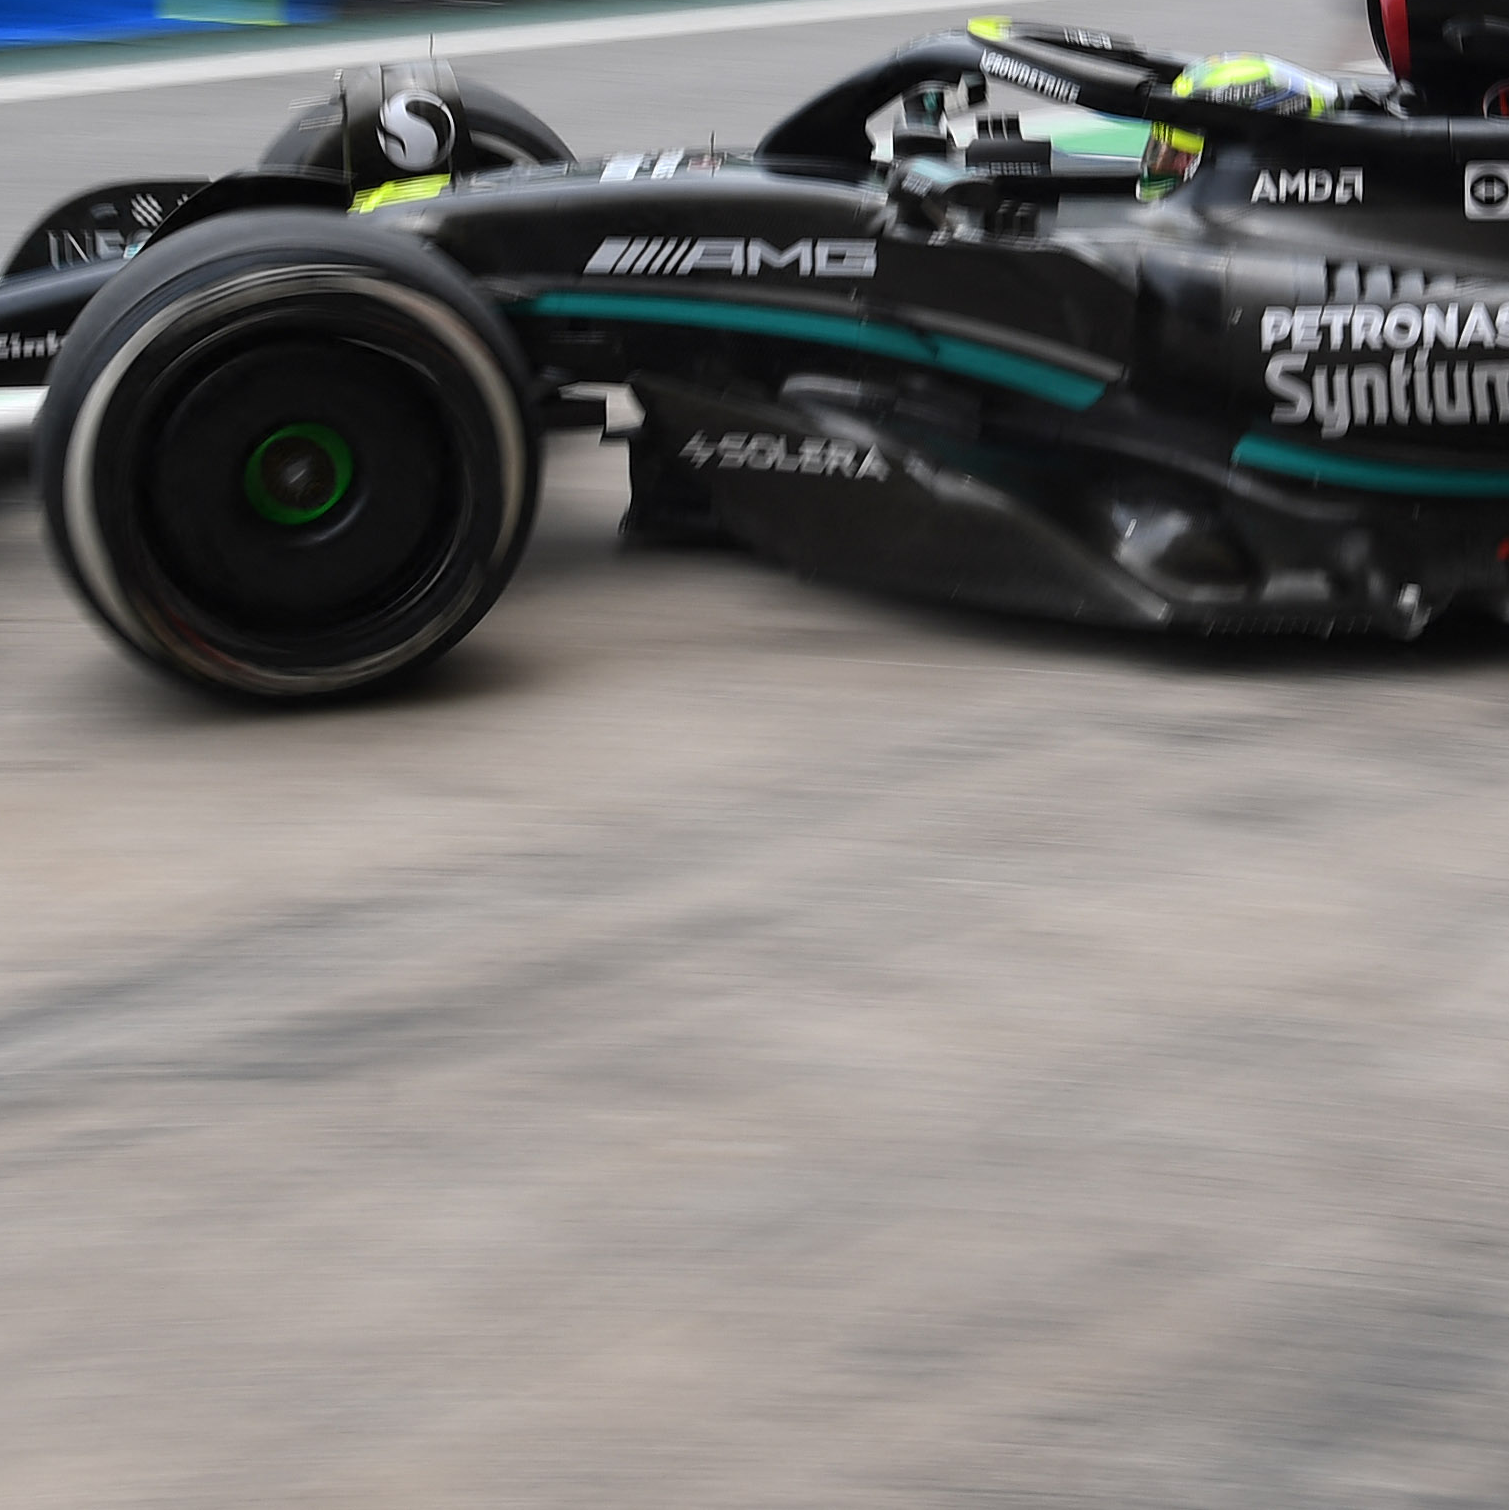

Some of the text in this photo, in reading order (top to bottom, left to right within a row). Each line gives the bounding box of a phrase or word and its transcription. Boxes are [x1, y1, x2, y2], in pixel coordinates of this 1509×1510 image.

[985, 50, 1081, 104] CROWDSTRIKE
[1250, 170, 1333, 204] AMD
[679, 237, 878, 277] AMG
[717, 430, 892, 483] SOLERA
